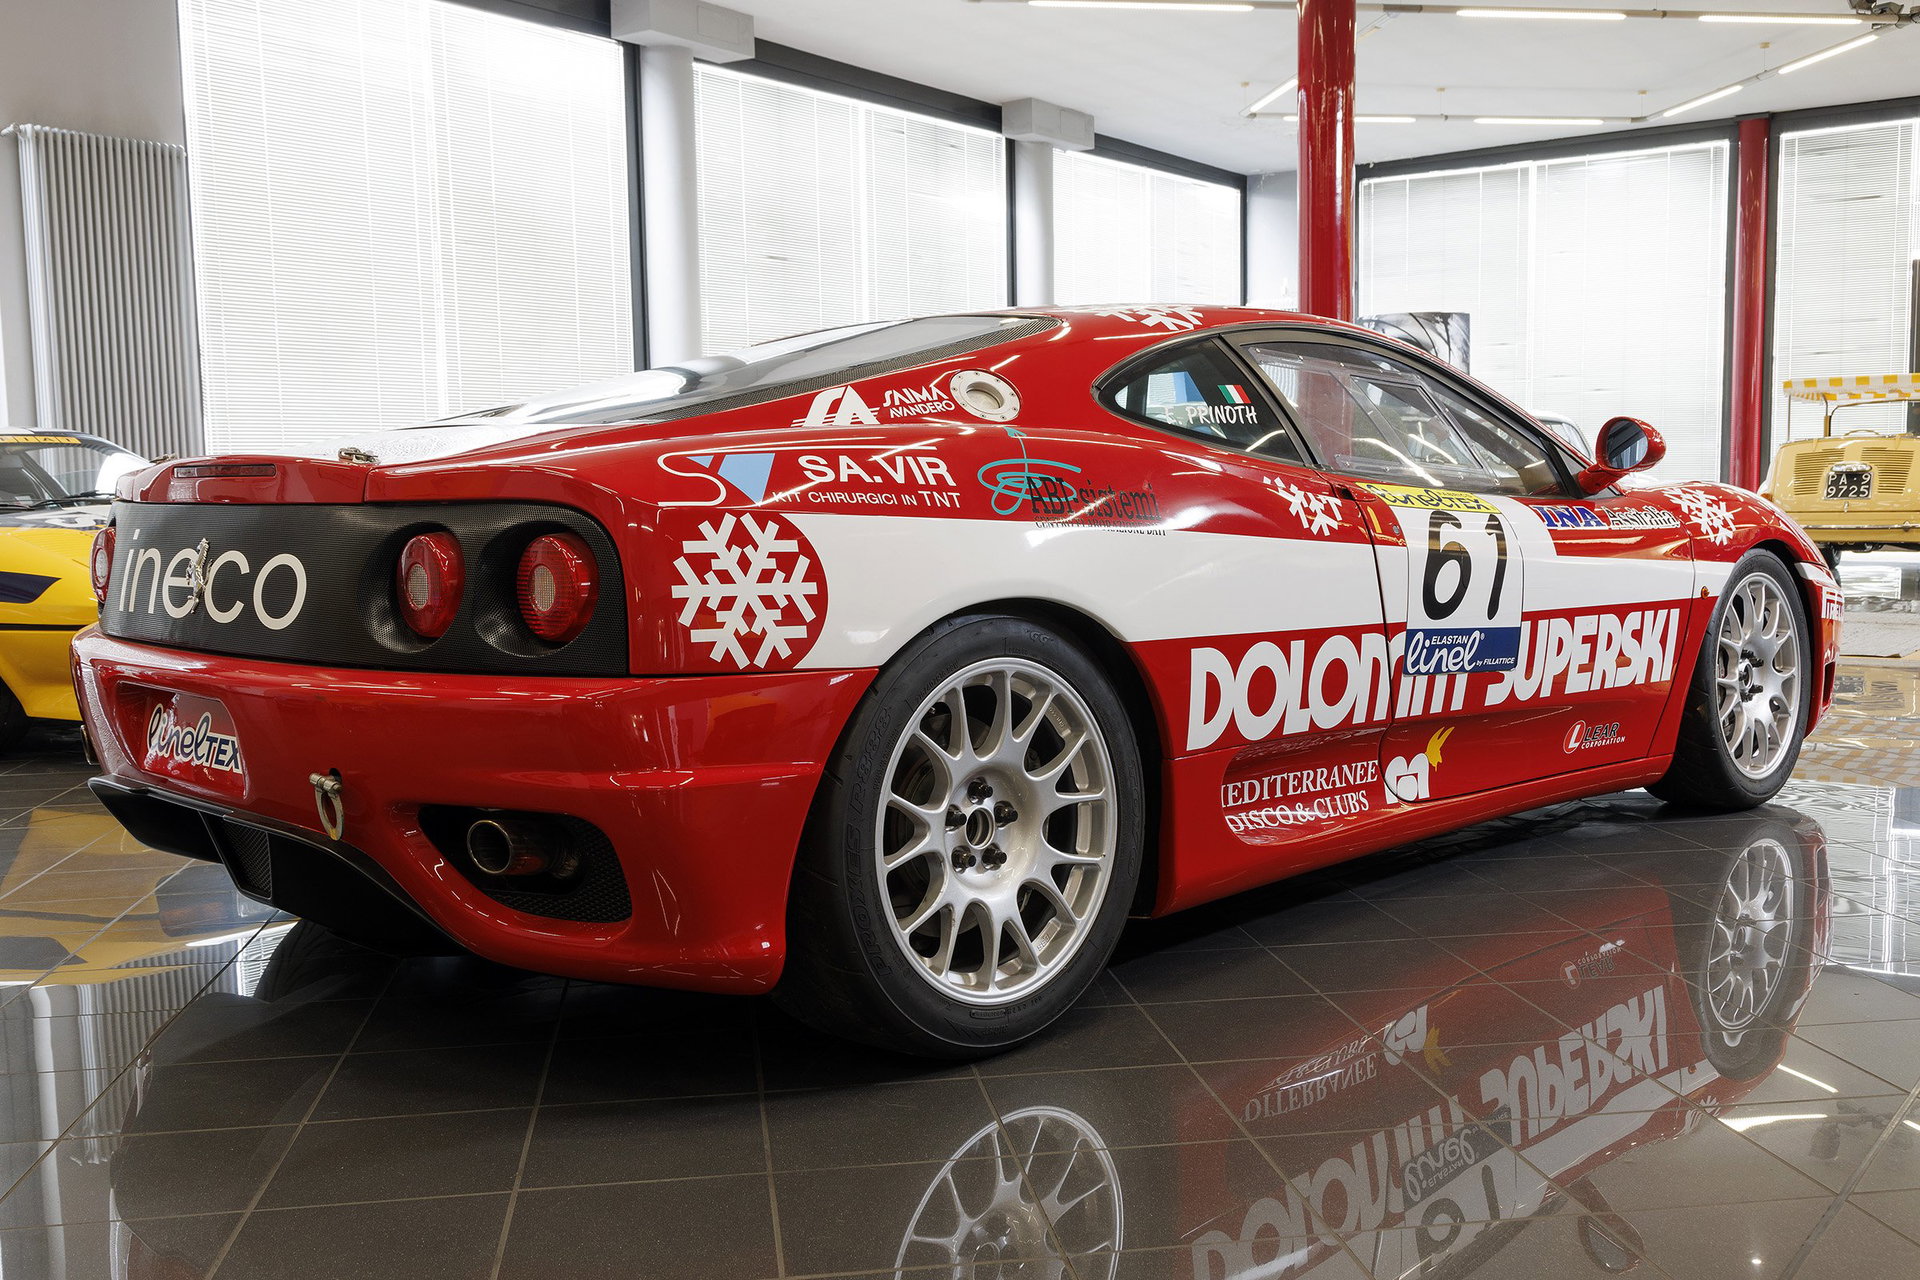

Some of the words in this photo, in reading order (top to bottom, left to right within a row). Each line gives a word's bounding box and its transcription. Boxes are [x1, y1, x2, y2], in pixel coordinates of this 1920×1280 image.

[883, 385, 949, 407] SAIMA
[890, 400, 955, 419] AVANDERO
[1185, 405, 1258, 425] PRINOTH
[798, 455, 957, 487] SA.VIR
[772, 491, 801, 503] KIT
[808, 491, 898, 505] CHIRURGICI
[901, 494, 917, 506] IN
[918, 490, 961, 508] TNT
[1827, 485, 1869, 498] 9725
[1532, 505, 1607, 529] INA
[1422, 511, 1508, 621] 61
[119, 529, 307, 630] ineco
[1431, 635, 1468, 645] ELASTAN
[1407, 630, 1480, 674] linel
[1483, 657, 1515, 665] FILLATTICE
[1583, 722, 1620, 742] LEAR
[1581, 736, 1626, 749] CORPORATION
[1225, 804, 1294, 832] DISCO
[1295, 802, 1316, 823] &
